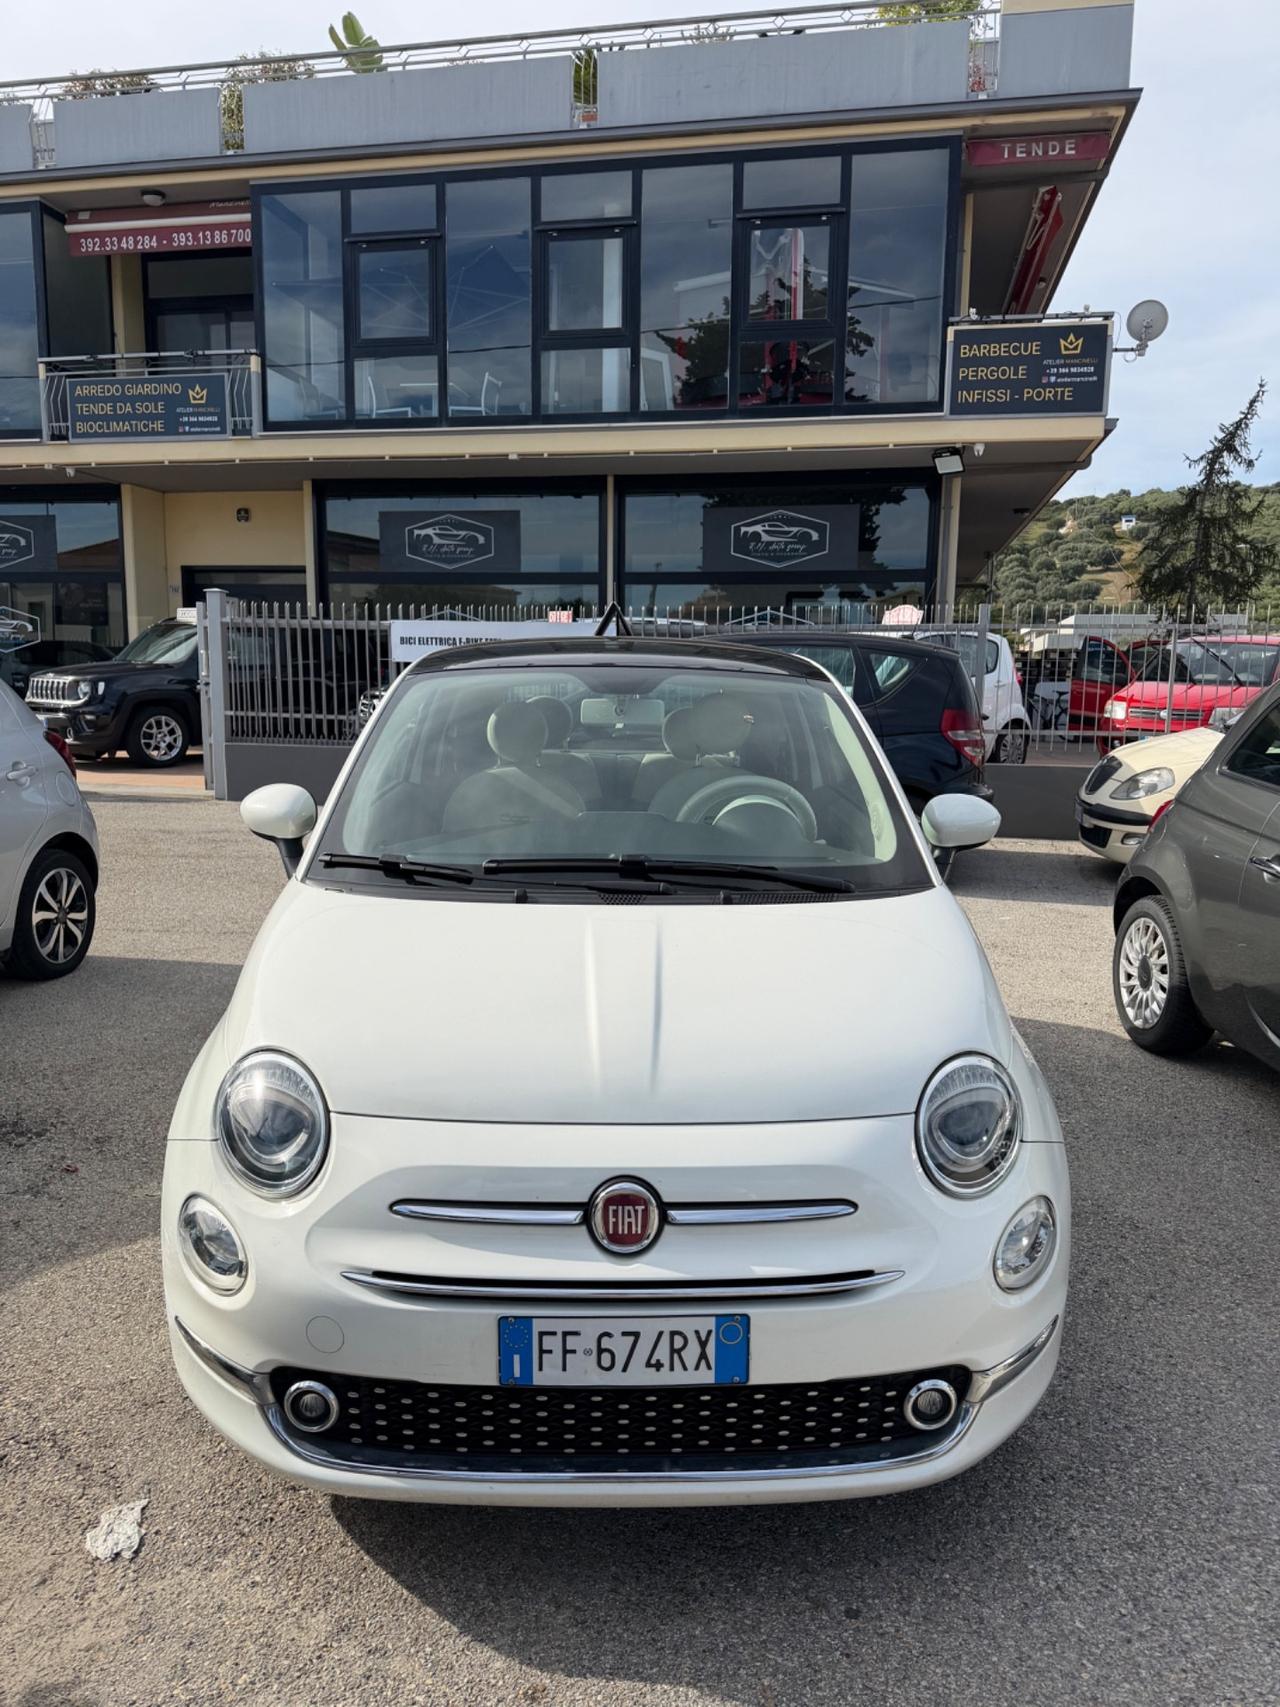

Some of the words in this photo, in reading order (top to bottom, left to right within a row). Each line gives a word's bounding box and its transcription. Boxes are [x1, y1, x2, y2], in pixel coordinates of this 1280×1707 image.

[1001, 140, 1076, 158] TENDE
[960, 341, 1041, 358] BARBECUE
[959, 365, 1028, 381] PERGOLE
[75, 384, 122, 397] ARREDO
[124, 383, 182, 396] GIARDINO
[957, 389, 1010, 404] INFISSI
[1023, 387, 1074, 401] PORTE
[75, 403, 114, 415] TENDE
[116, 402, 133, 415] DA
[135, 402, 165, 414] SOLE
[76, 420, 165, 433] BIOCLIMATICHE
[400, 636, 416, 645] BICI
[418, 637, 457, 647] ELETTRICA
[608, 1205, 645, 1235] FIAT
